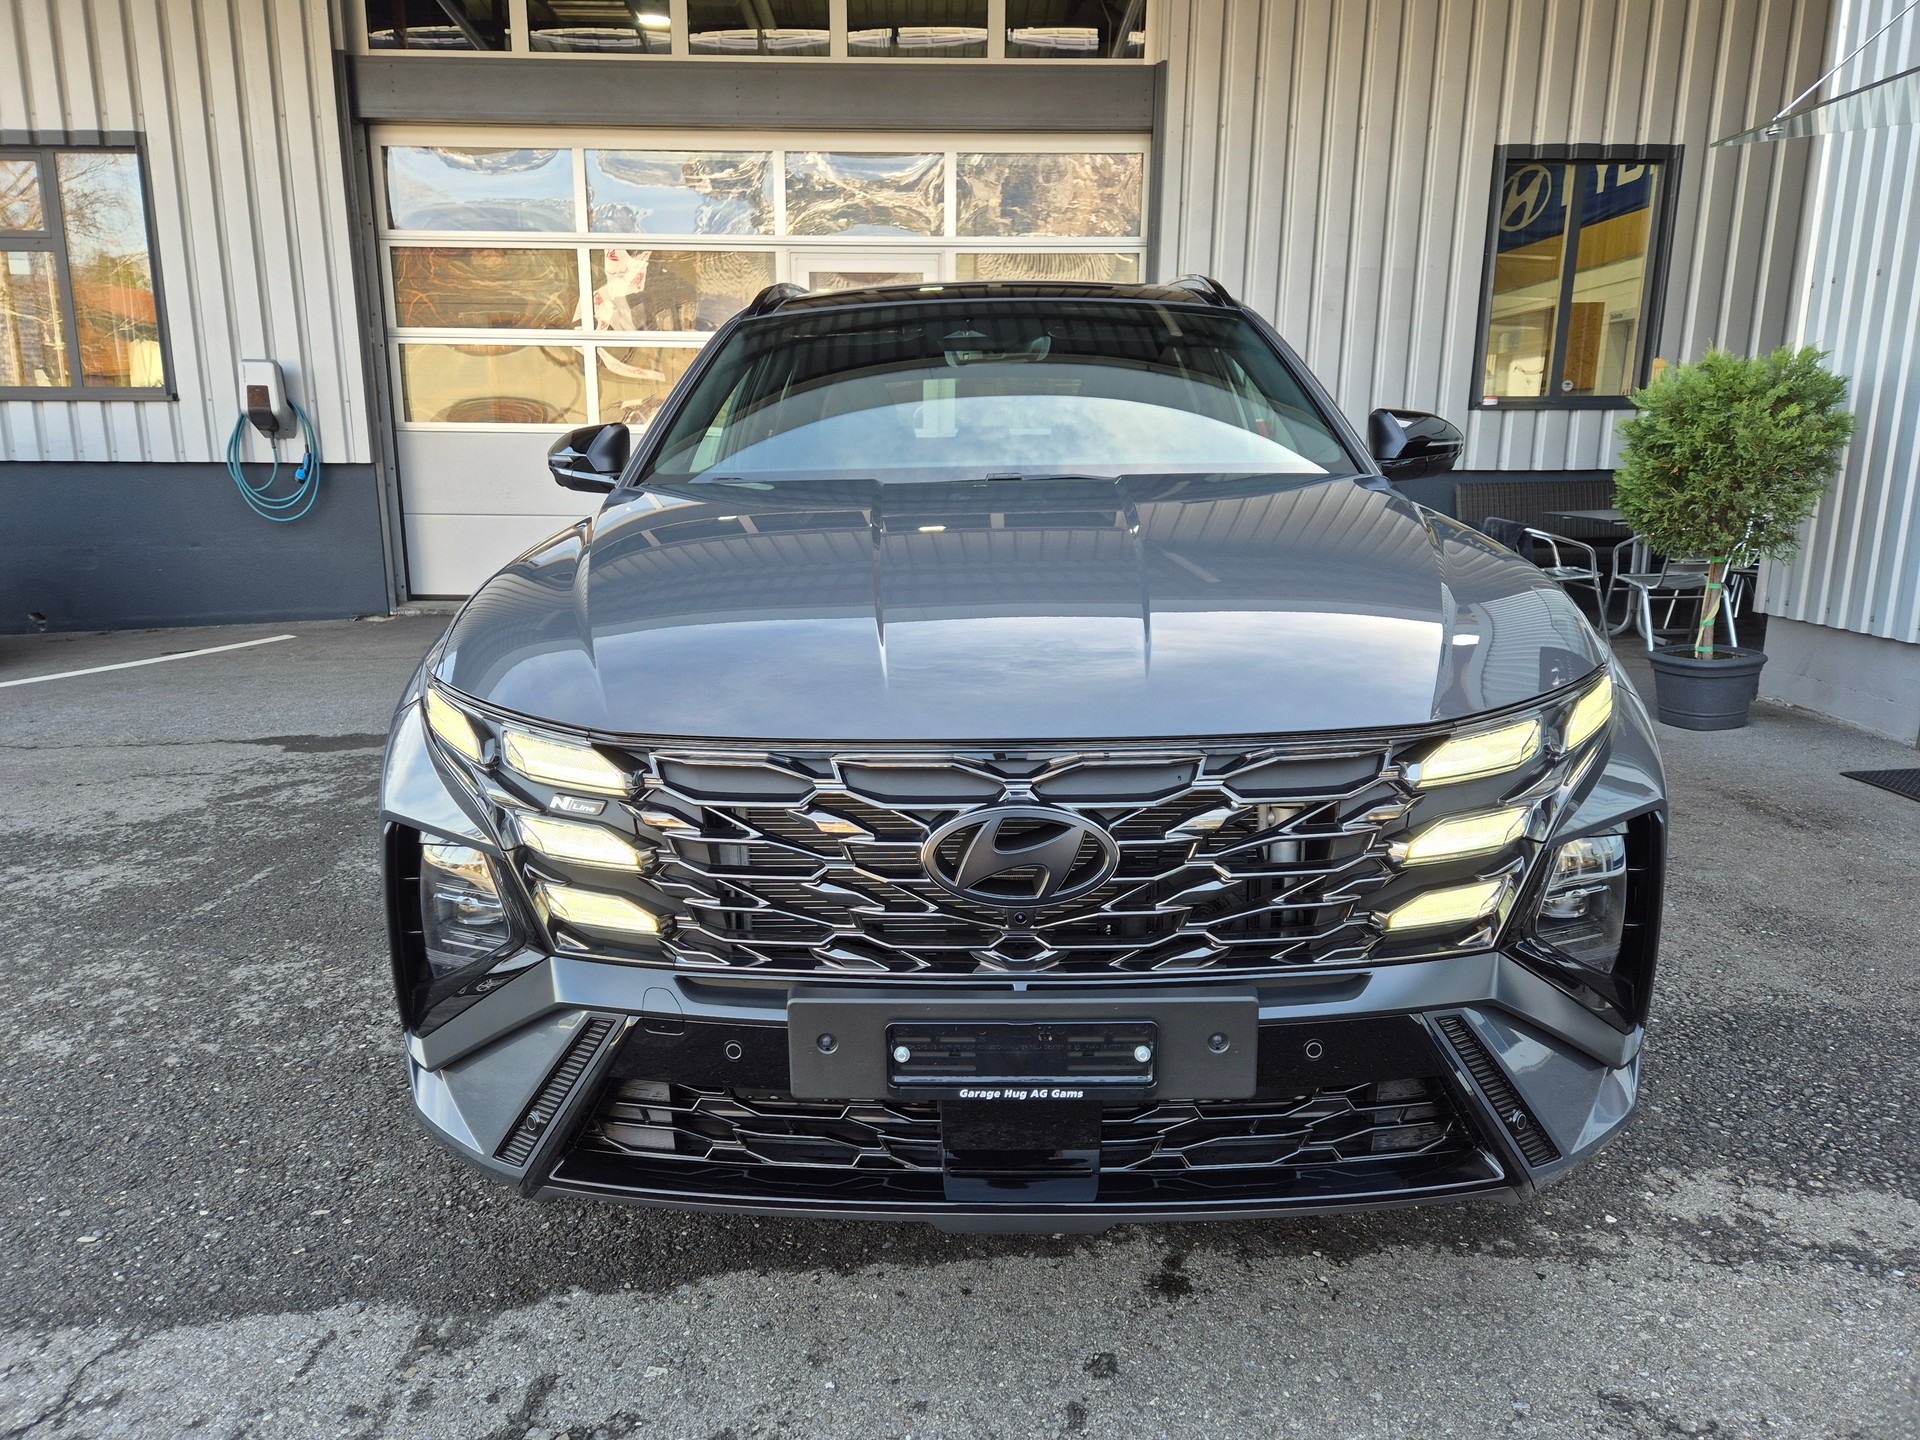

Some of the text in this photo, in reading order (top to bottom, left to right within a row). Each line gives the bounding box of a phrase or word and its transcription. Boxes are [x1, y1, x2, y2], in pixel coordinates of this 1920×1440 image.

[550, 795, 596, 813] N Line
[959, 1089, 1083, 1100] Garage Hug AG Gams
